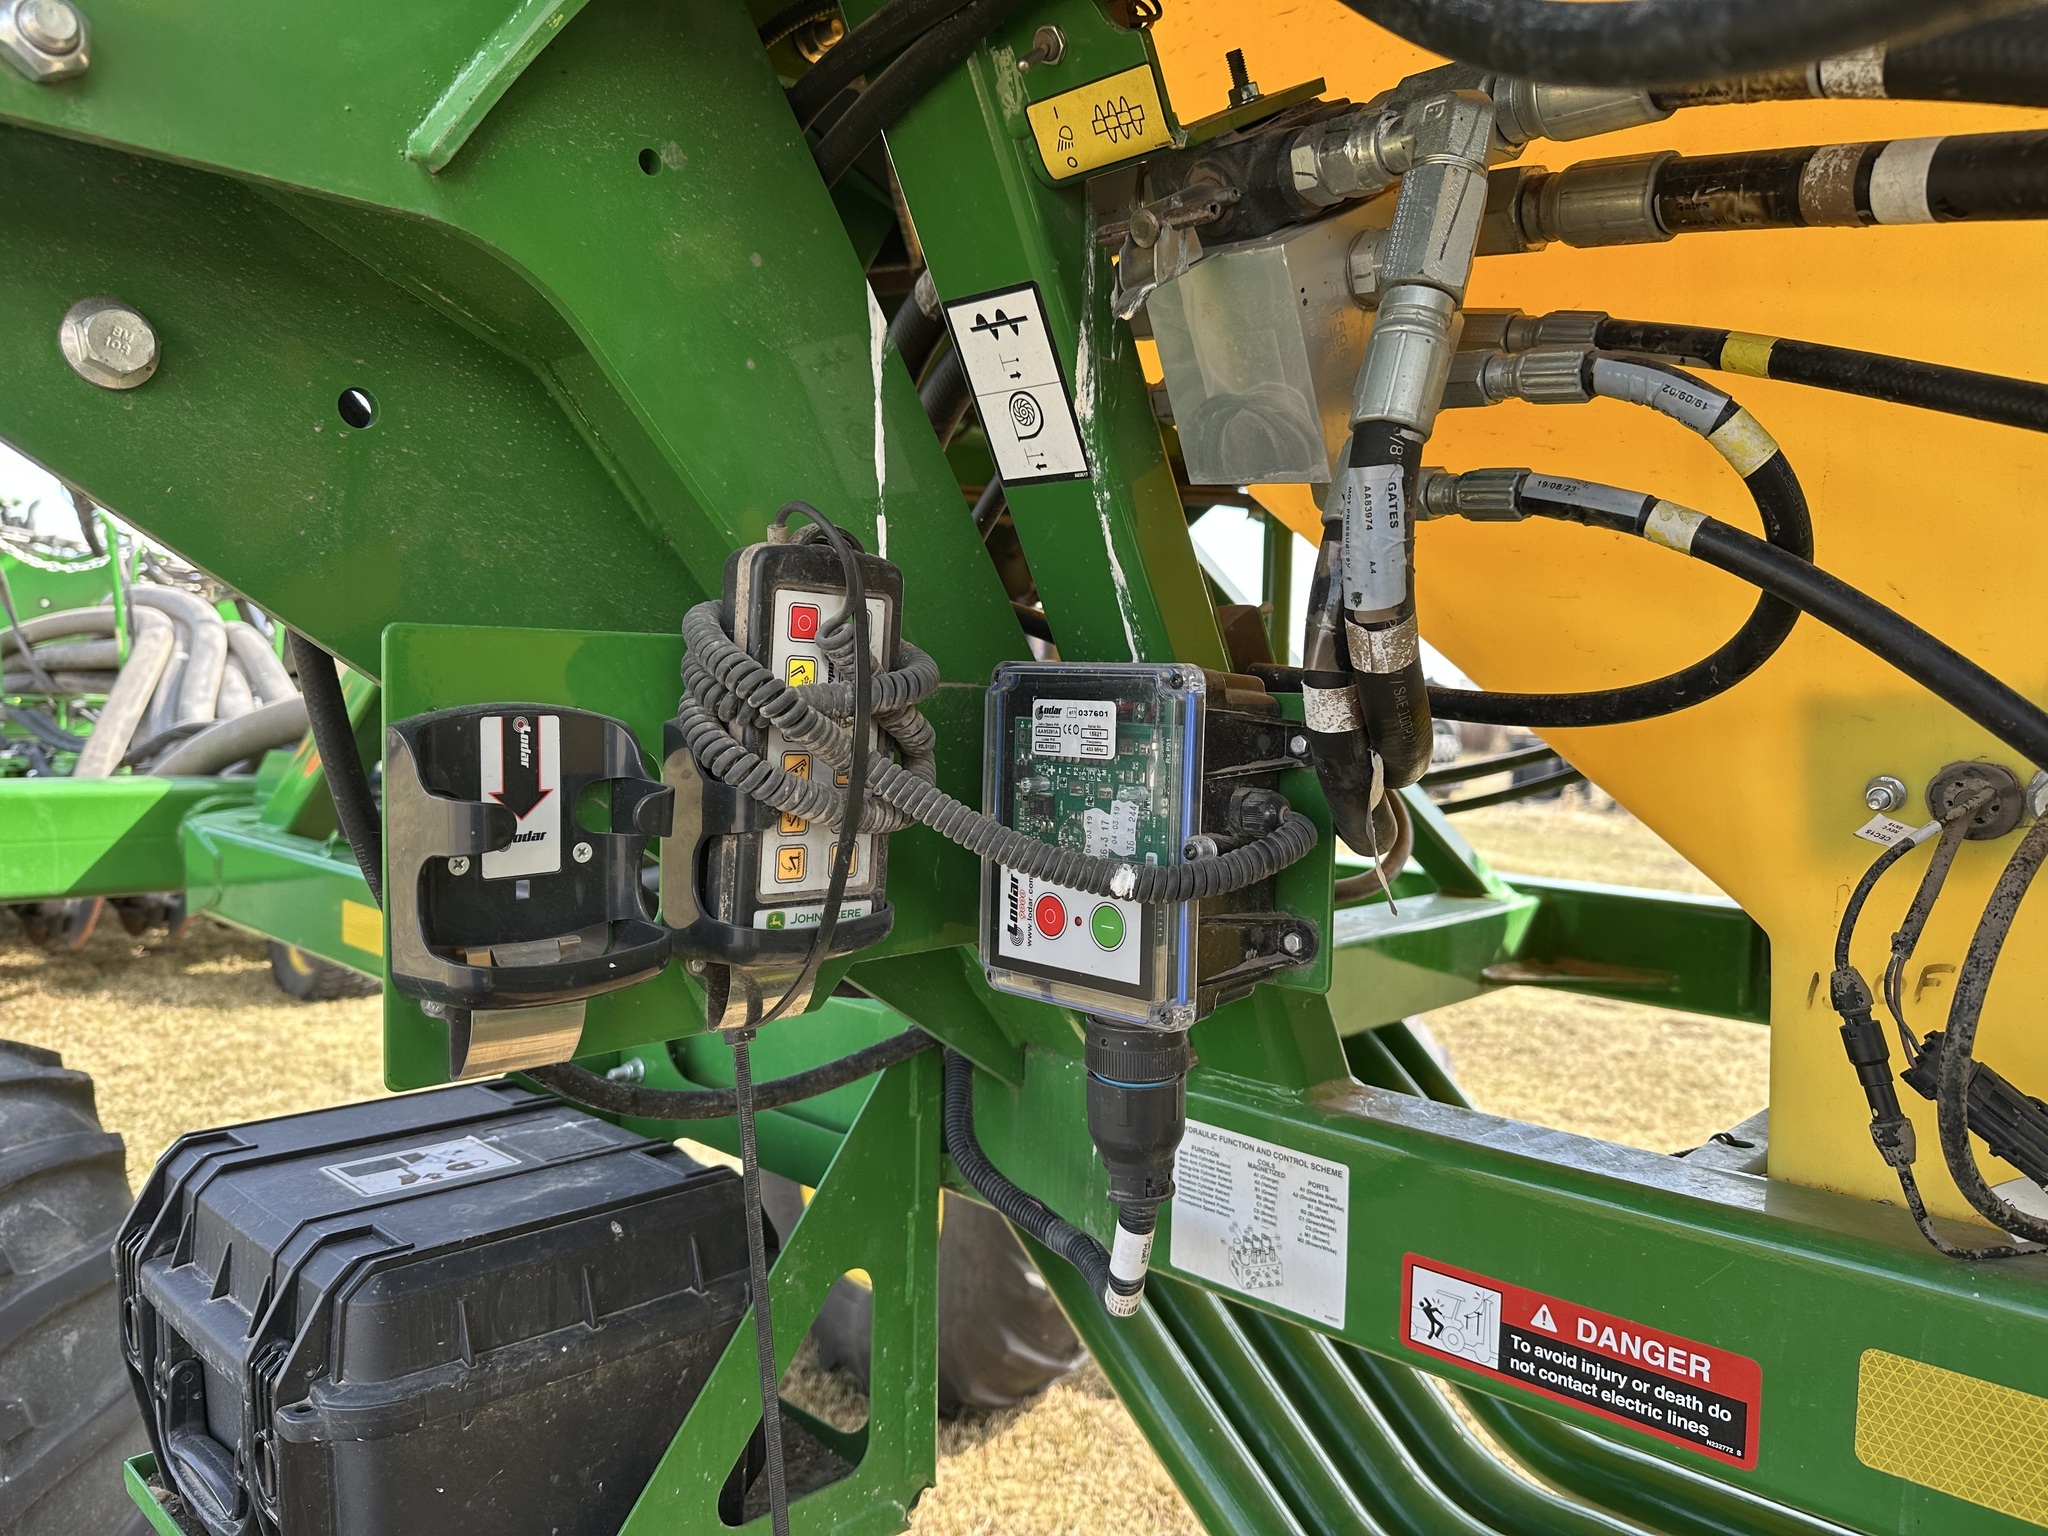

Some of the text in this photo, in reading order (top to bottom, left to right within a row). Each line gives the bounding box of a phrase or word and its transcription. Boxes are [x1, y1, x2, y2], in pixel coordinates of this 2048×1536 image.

[1662, 384, 1708, 411] 19/09/02
[1363, 485, 1373, 531] AA83974
[1387, 481, 1399, 529] GATES
[1393, 686, 1410, 709] SAE
[1039, 705, 1063, 715] Lodar
[1078, 710, 1109, 718] 037601
[519, 725, 532, 769] Lodar
[513, 830, 547, 844] odar
[1007, 874, 1019, 936] Lodar
[790, 912, 822, 925] JOHN
[1185, 1126, 1343, 1179] YDRAULIC FUNCTION AND CONTROL SCHEME
[1191, 1144, 1220, 1158] FUNCTION
[1247, 1162, 1286, 1179] MAGNETIZED
[1257, 1159, 1276, 1170] COILS
[1308, 1180, 1329, 1193] PORTS
[1576, 1316, 1711, 1383] DANGER
[1510, 1334, 1732, 1423] To avoid injury or death do
[1509, 1357, 1710, 1438] not contact electric lines
[1706, 1439, 1734, 1454] N232772
